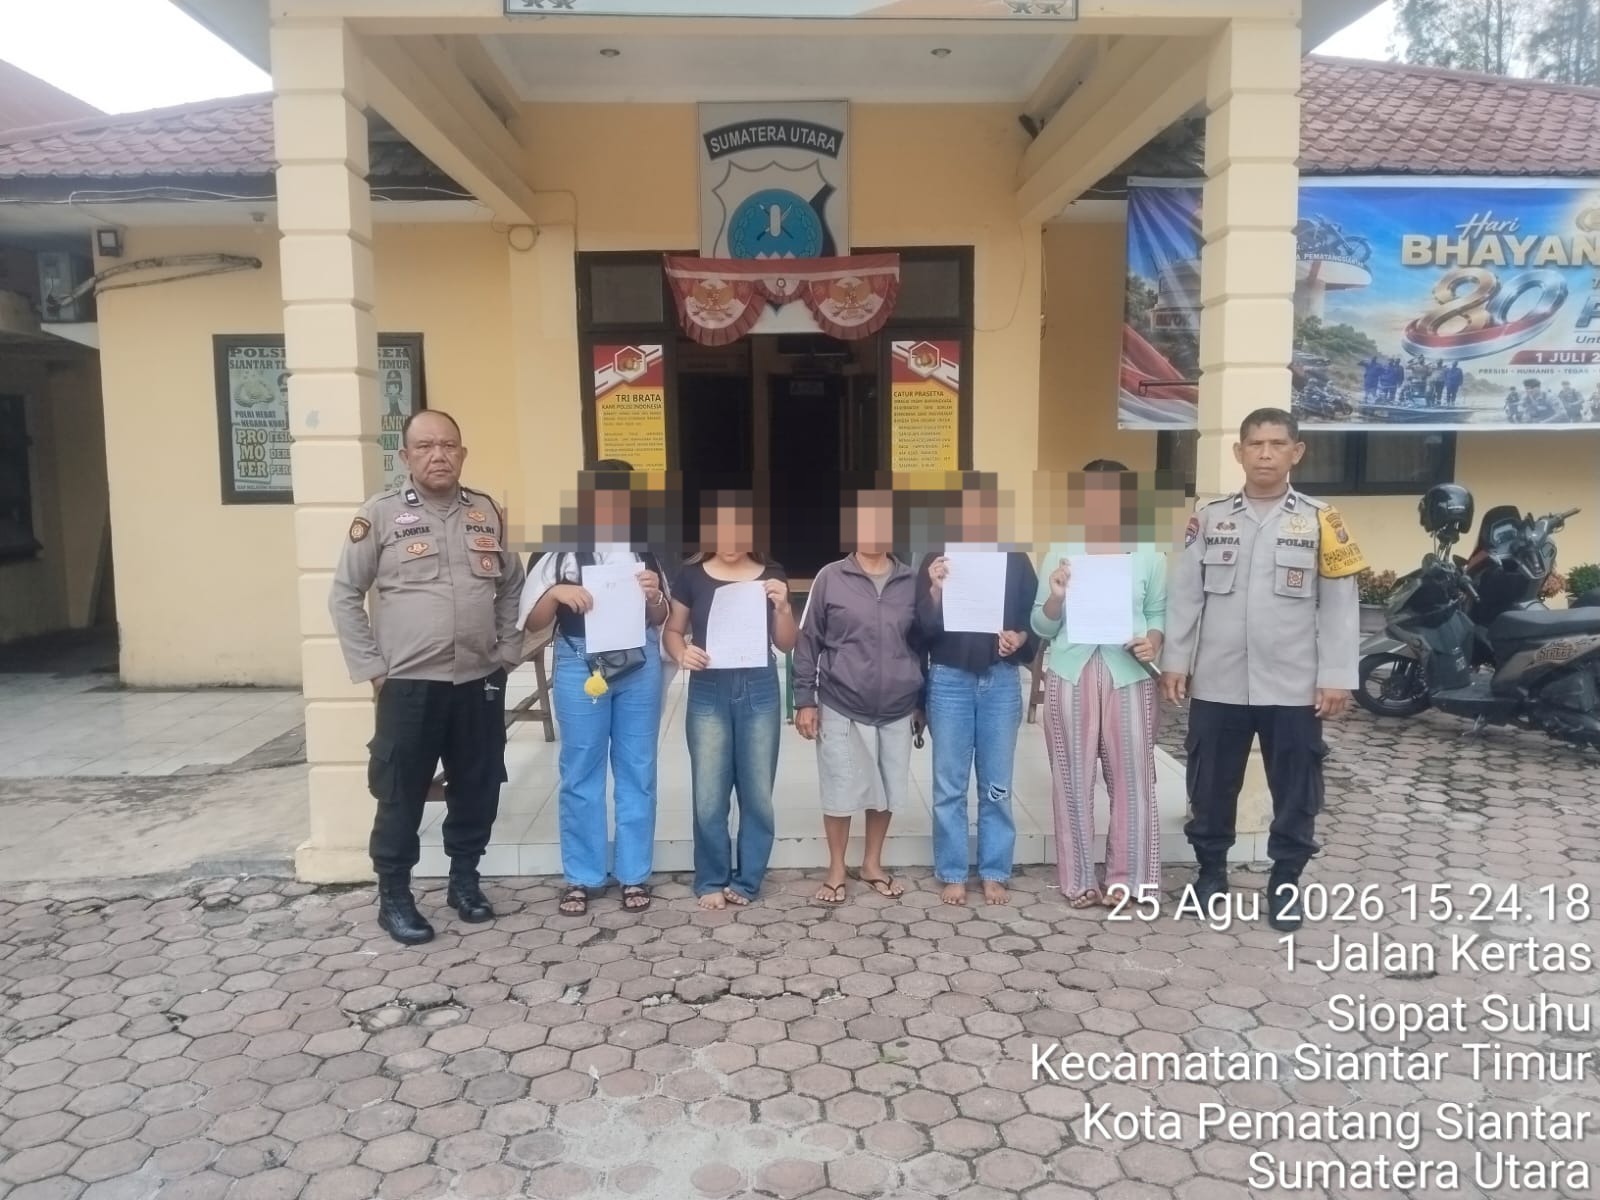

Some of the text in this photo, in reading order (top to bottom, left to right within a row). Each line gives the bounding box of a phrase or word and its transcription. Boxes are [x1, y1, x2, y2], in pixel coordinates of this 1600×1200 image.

[710, 125, 836, 153] SUMATERA UTARA
[1455, 209, 1520, 239] Hari
[1535, 352, 1543, 363] 1
[1549, 352, 1587, 363] JULI
[228, 359, 274, 370] SIANTAR
[1516, 367, 1555, 375] HUMANIS
[615, 393, 662, 403] TRI BRATA
[893, 390, 914, 398] CATUR
[235, 428, 268, 446] PRO
[240, 444, 265, 461] MO
[238, 460, 268, 477] TER
[466, 524, 495, 535] POLRI
[1276, 538, 1315, 549] POLRI
